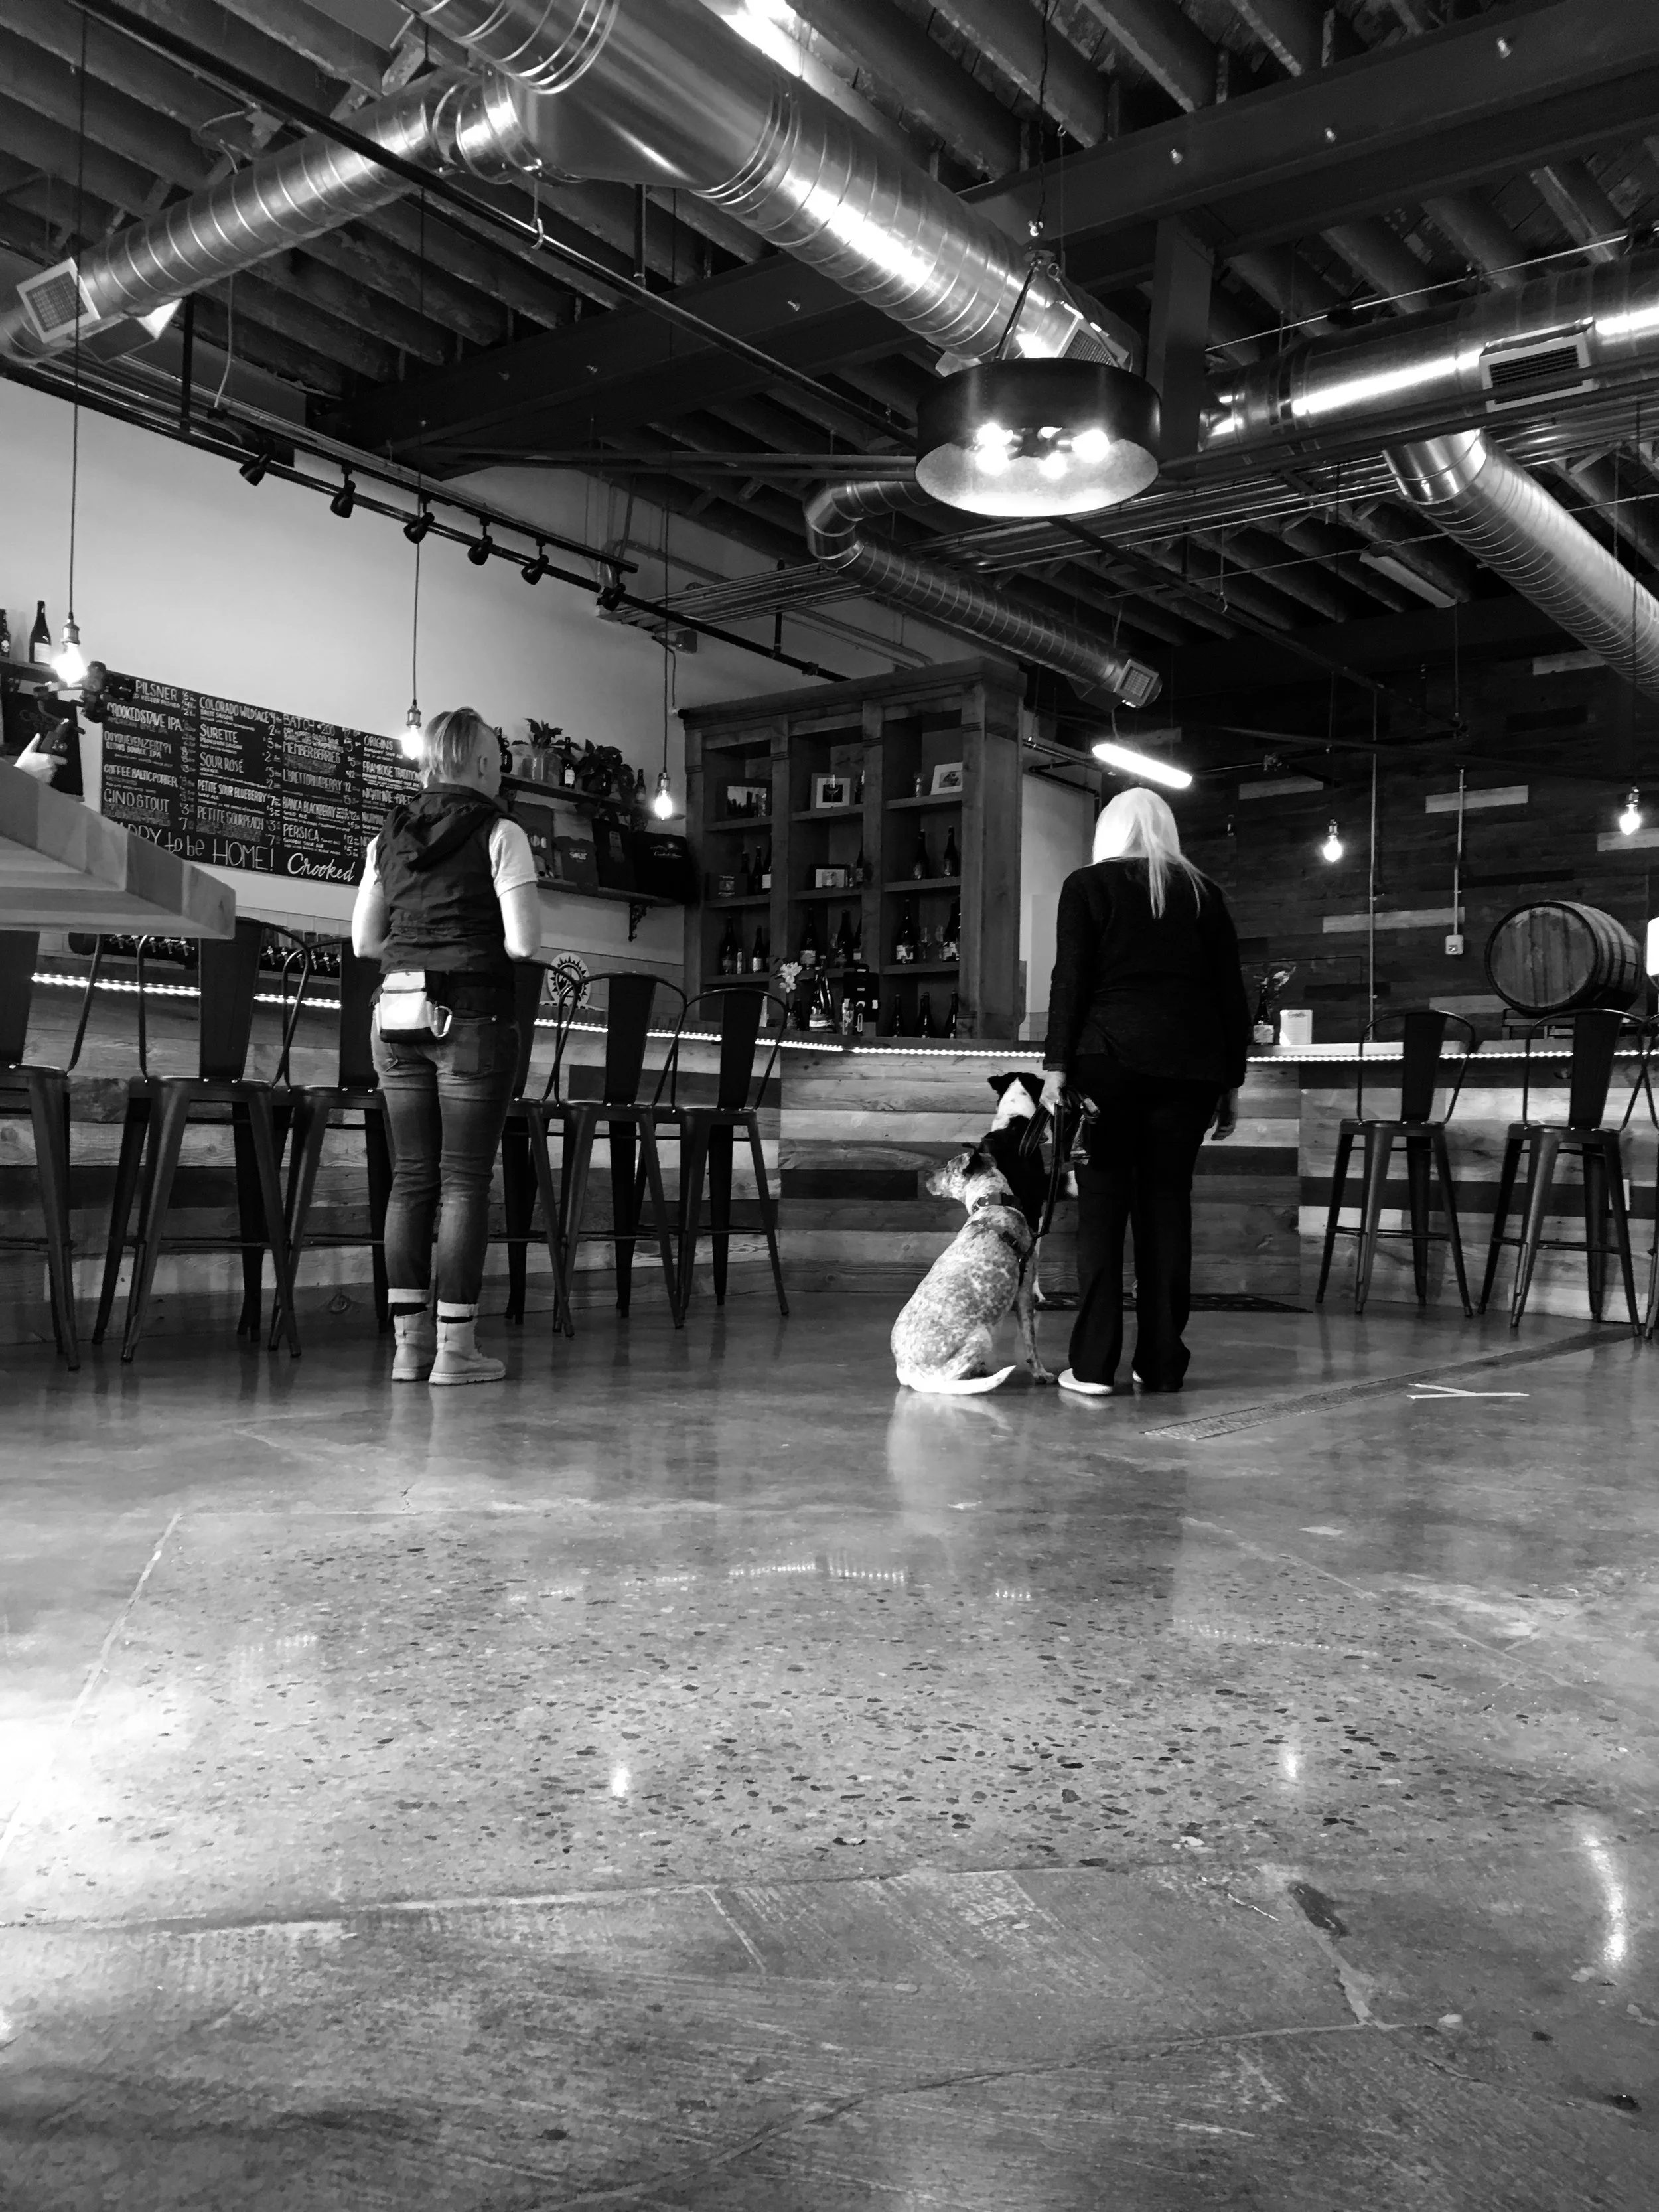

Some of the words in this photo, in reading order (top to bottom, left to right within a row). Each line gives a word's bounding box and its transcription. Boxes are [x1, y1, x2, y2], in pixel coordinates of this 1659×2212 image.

[136, 680, 177, 701] PILSNER
[200, 696, 239, 717] COLORADO
[140, 709, 166, 727] STAVE
[168, 716, 185, 731] IPA
[283, 713, 315, 731] BATCH
[200, 723, 238, 743] SURETTE
[149, 750, 162, 759] IPA
[200, 751, 223, 770] SOUR
[224, 758, 244, 774] ROSÉ
[104, 764, 131, 778] COFFEE
[131, 768, 152, 782] BALTIC
[151, 773, 179, 788] PORTER
[198, 779, 217, 794] PETITE
[198, 806, 226, 824] PETITE
[283, 823, 319, 842] PERSICA
[164, 832, 183, 854] to
[186, 834, 205, 857] be
[212, 838, 274, 871] HOME!
[287, 853, 355, 883] Crooked
